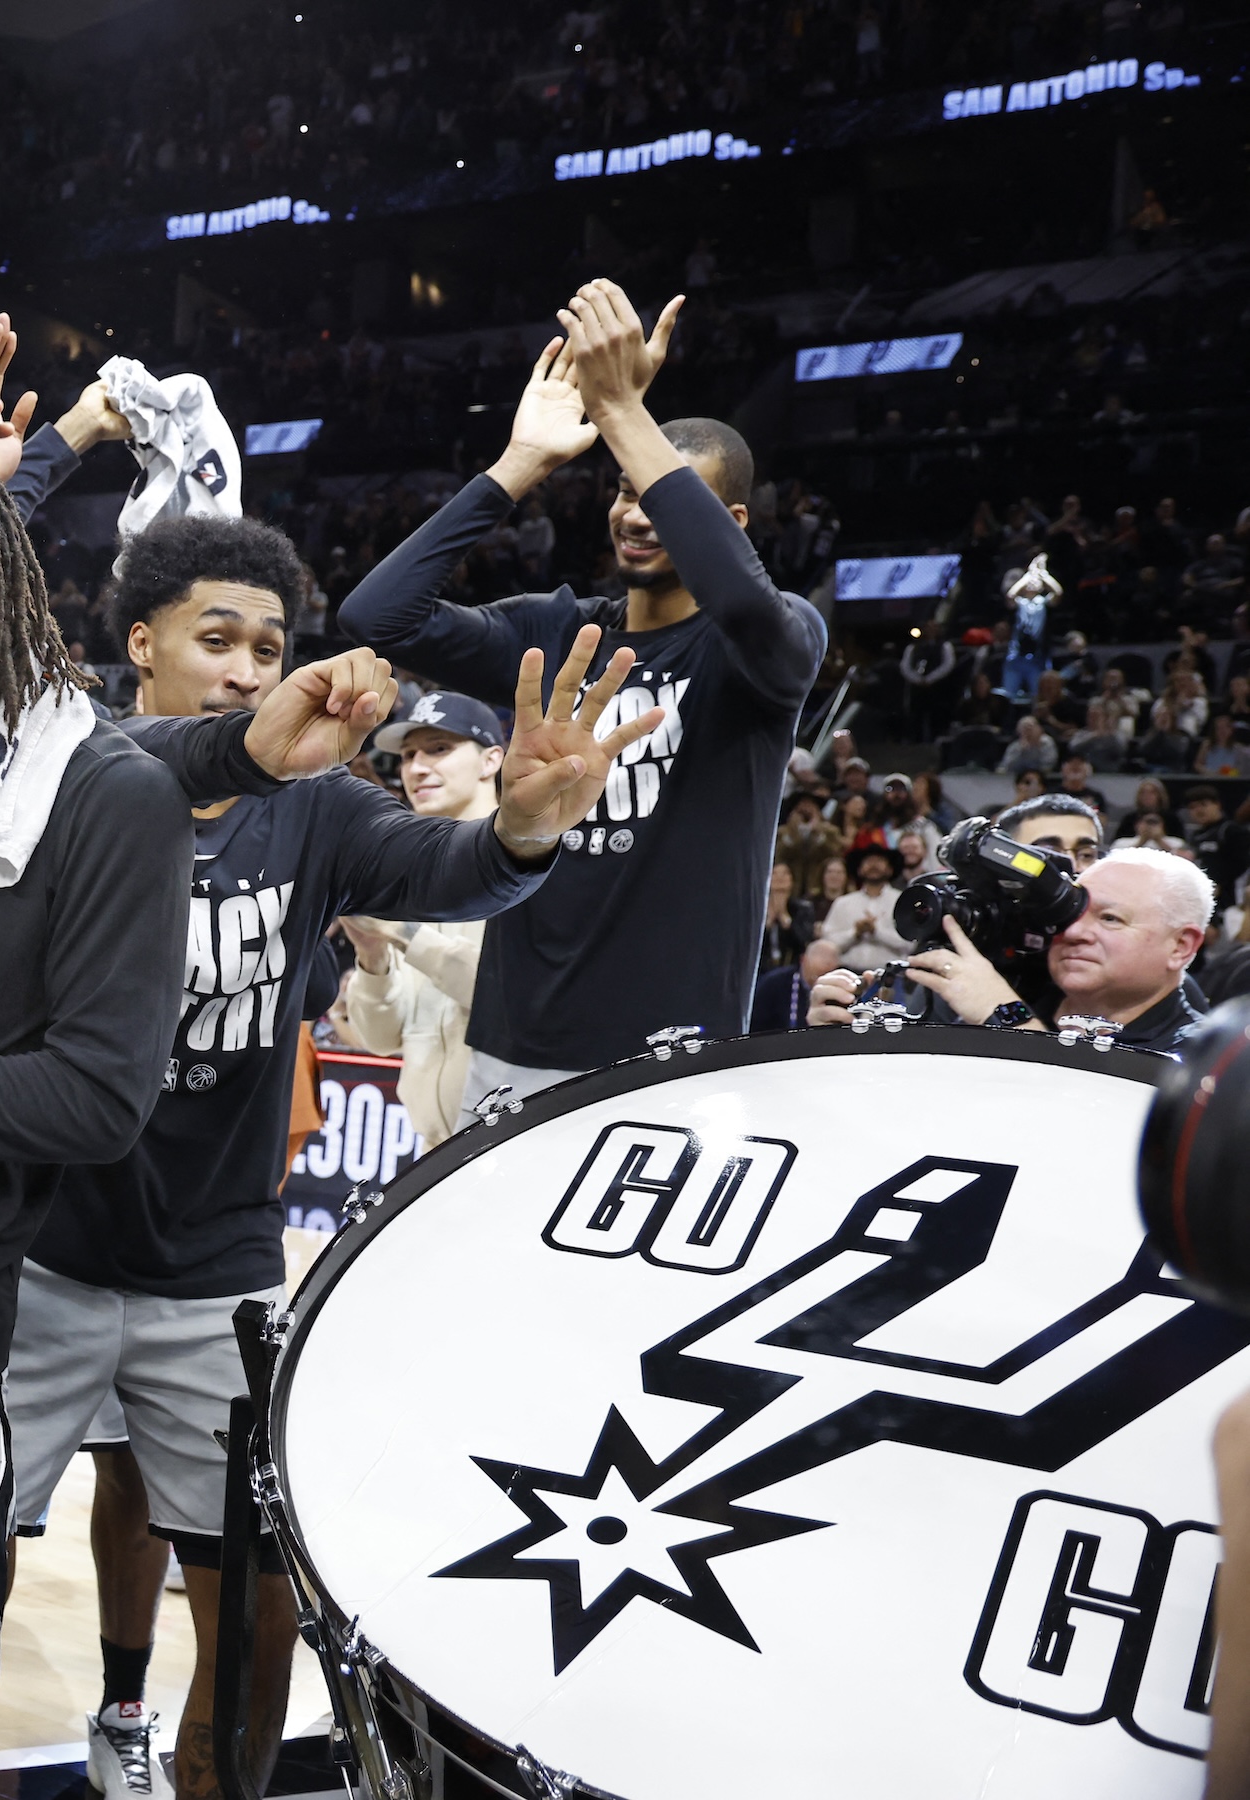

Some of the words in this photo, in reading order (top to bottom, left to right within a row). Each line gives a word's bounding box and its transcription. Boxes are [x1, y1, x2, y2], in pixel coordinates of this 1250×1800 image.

[943, 84, 1003, 120] SAN
[1006, 57, 1139, 113] ANTONIO
[555, 149, 604, 181] SAN
[605, 129, 712, 176] ANTONIO
[166, 211, 207, 241] SAN
[206, 195, 292, 236] ANTONIO
[183, 880, 295, 995] ACK
[541, 1121, 799, 1275] GO
